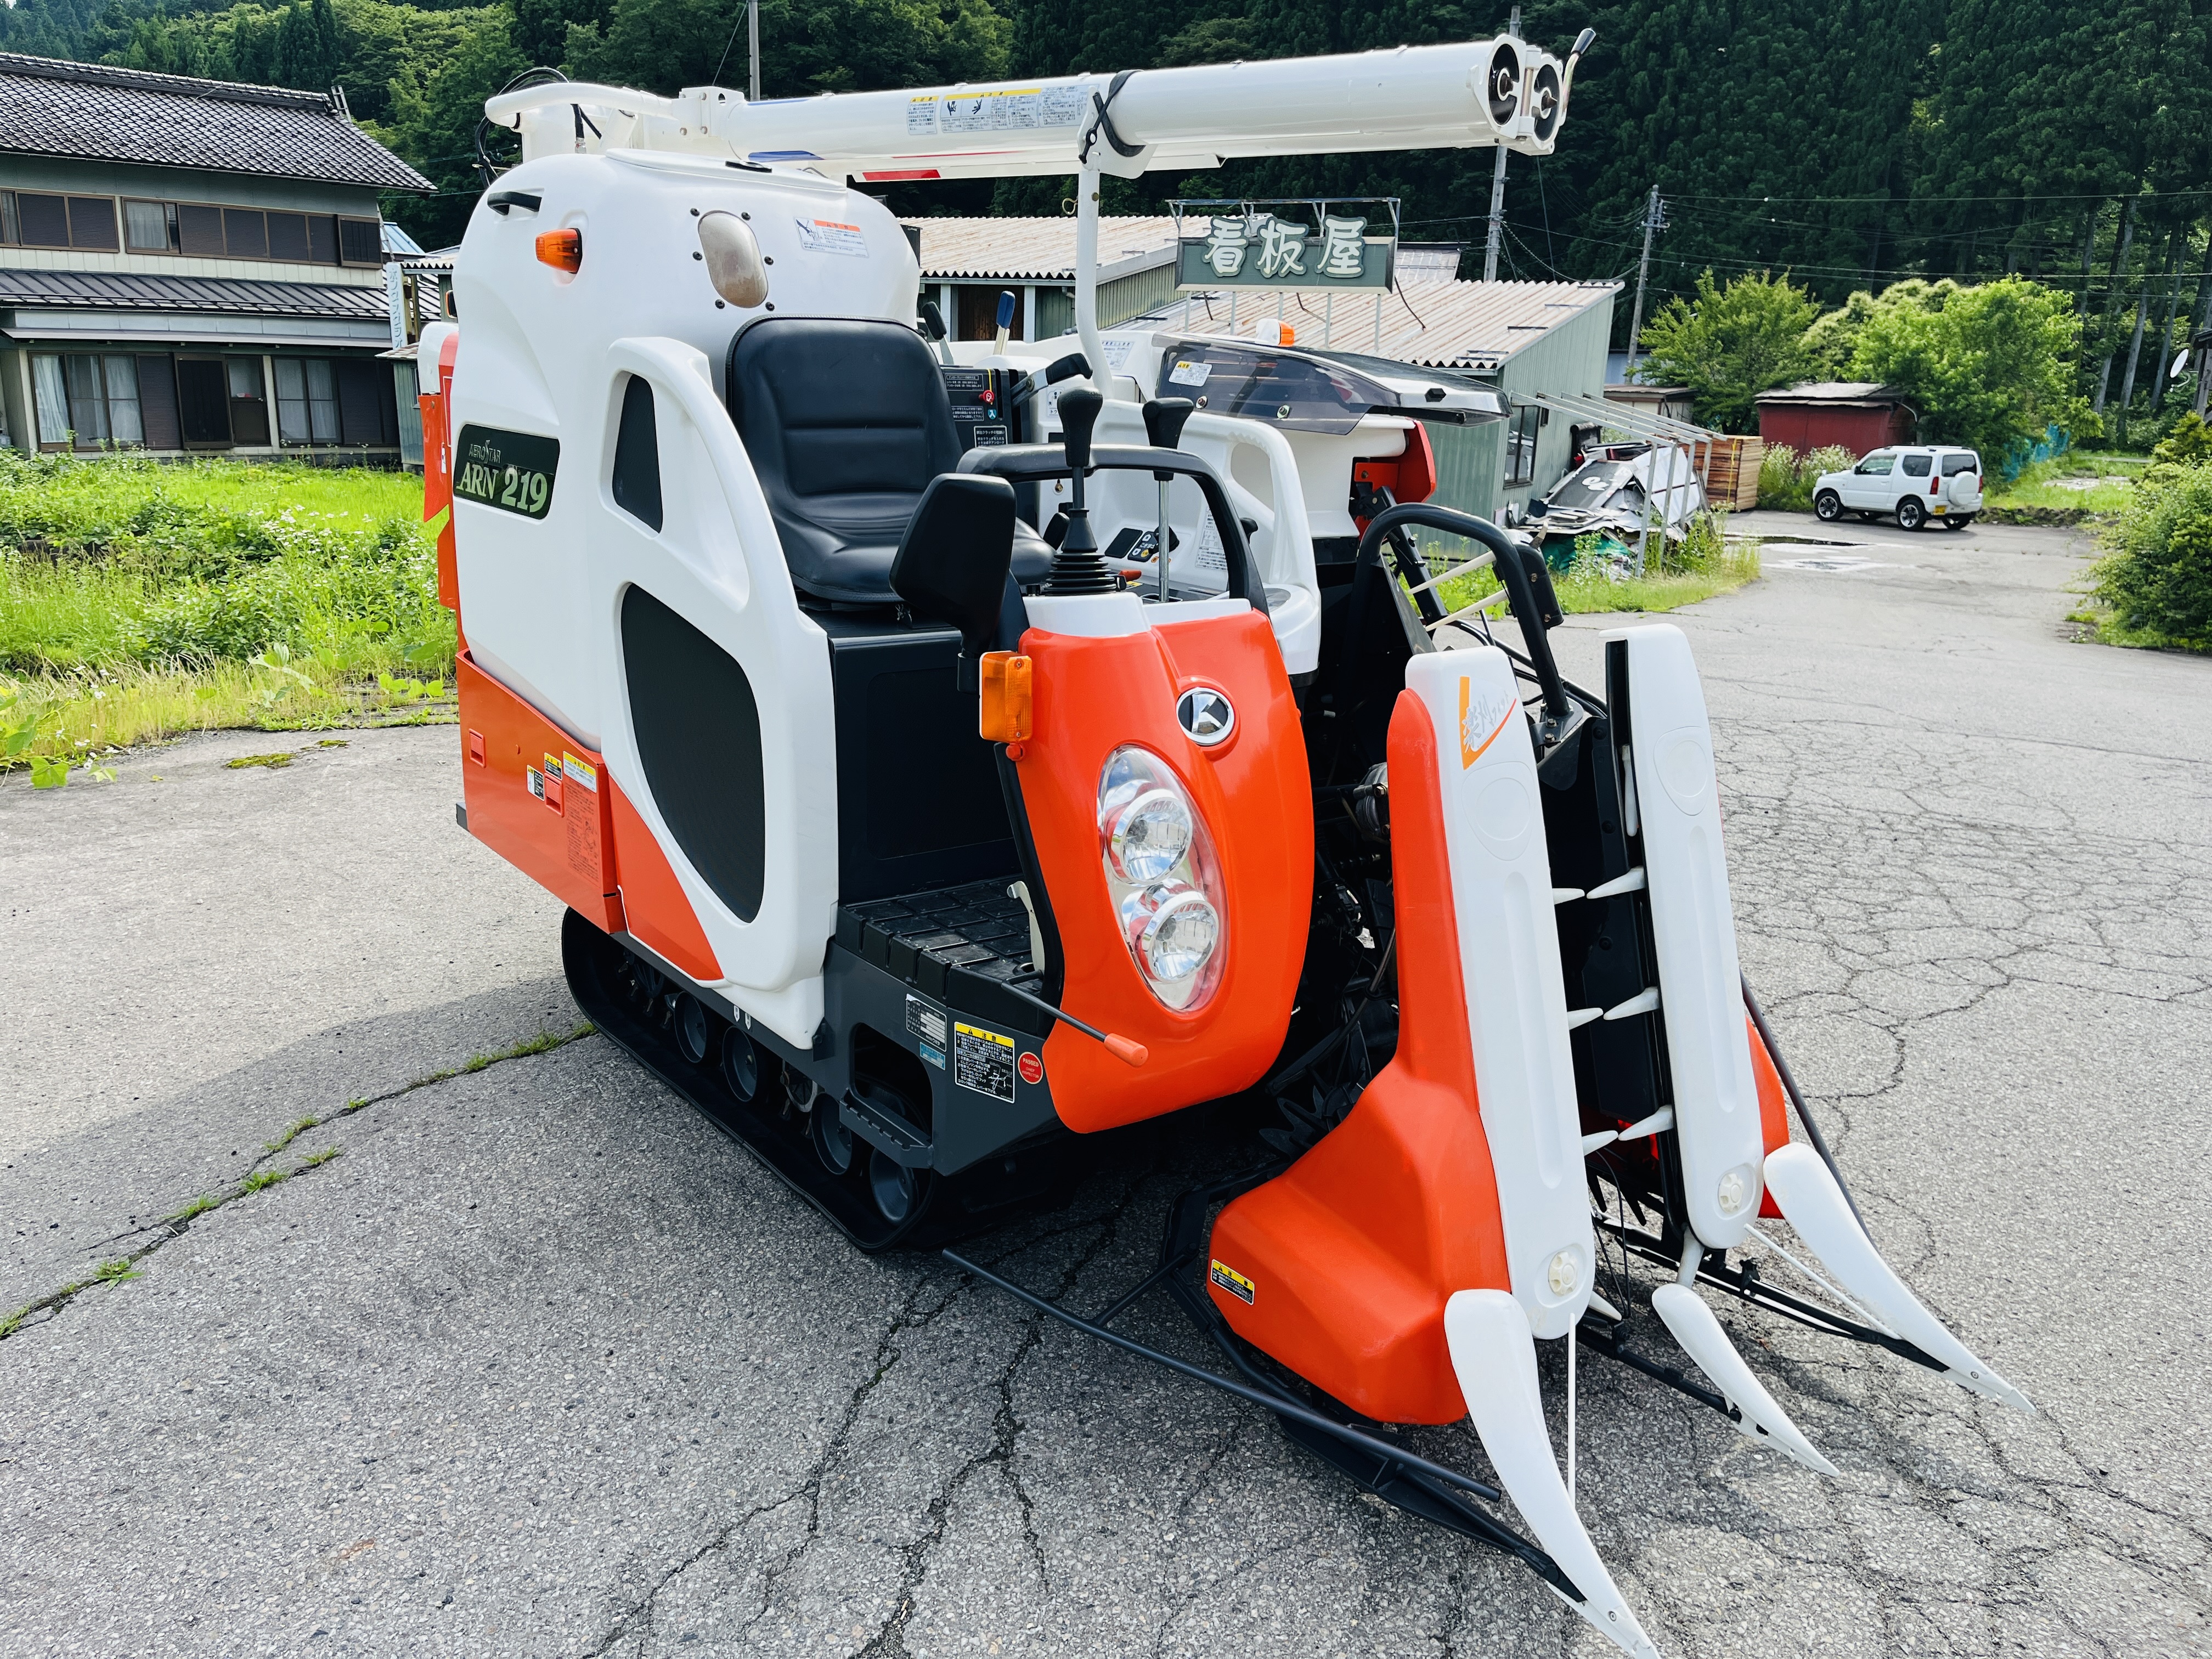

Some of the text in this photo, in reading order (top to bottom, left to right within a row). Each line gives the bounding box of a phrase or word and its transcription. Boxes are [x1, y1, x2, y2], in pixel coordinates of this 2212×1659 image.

[1203, 216, 1365, 276] 看板屋
[456, 462, 548, 514] ARN 219
[1023, 1058, 1039, 1067] PASSED
